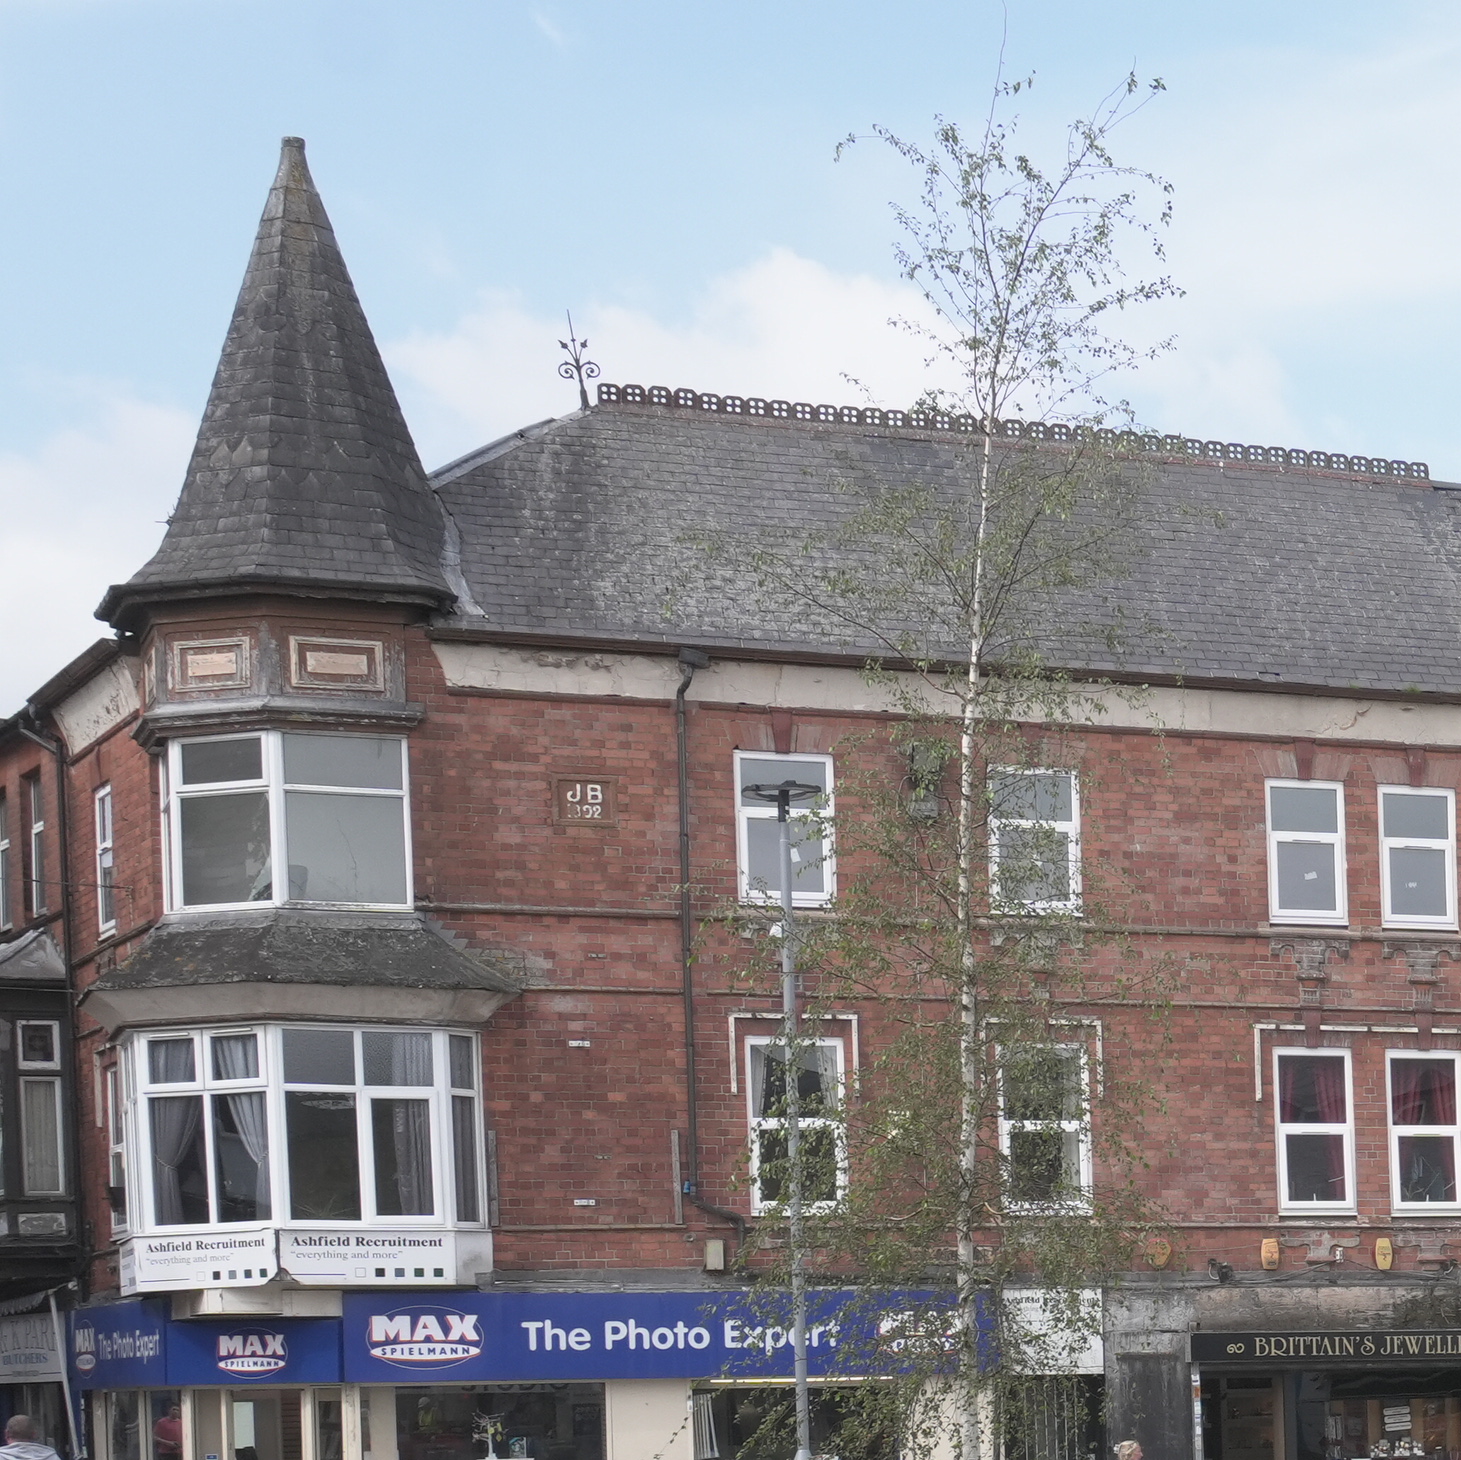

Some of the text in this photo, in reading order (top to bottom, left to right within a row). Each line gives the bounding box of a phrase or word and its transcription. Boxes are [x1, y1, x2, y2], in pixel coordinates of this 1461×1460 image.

[146, 1237, 266, 1254] Ashfield Recruitment
[290, 1236, 444, 1248] Ashfield Recruitment
[195, 1253, 210, 1264] and
[351, 1250, 370, 1260] and
[371, 1314, 480, 1342] MAX
[521, 1319, 592, 1351] The
[604, 1318, 711, 1351] Photo
[75, 1328, 160, 1365] MAX The Photo Expert
[218, 1334, 285, 1356] MAX
[380, 1345, 471, 1357] SPIELMANN
[1253, 1335, 1375, 1357] BRITTAIN'S
[3, 1352, 49, 1366] BUTCHERS
[223, 1360, 281, 1370] SPIELMANN
